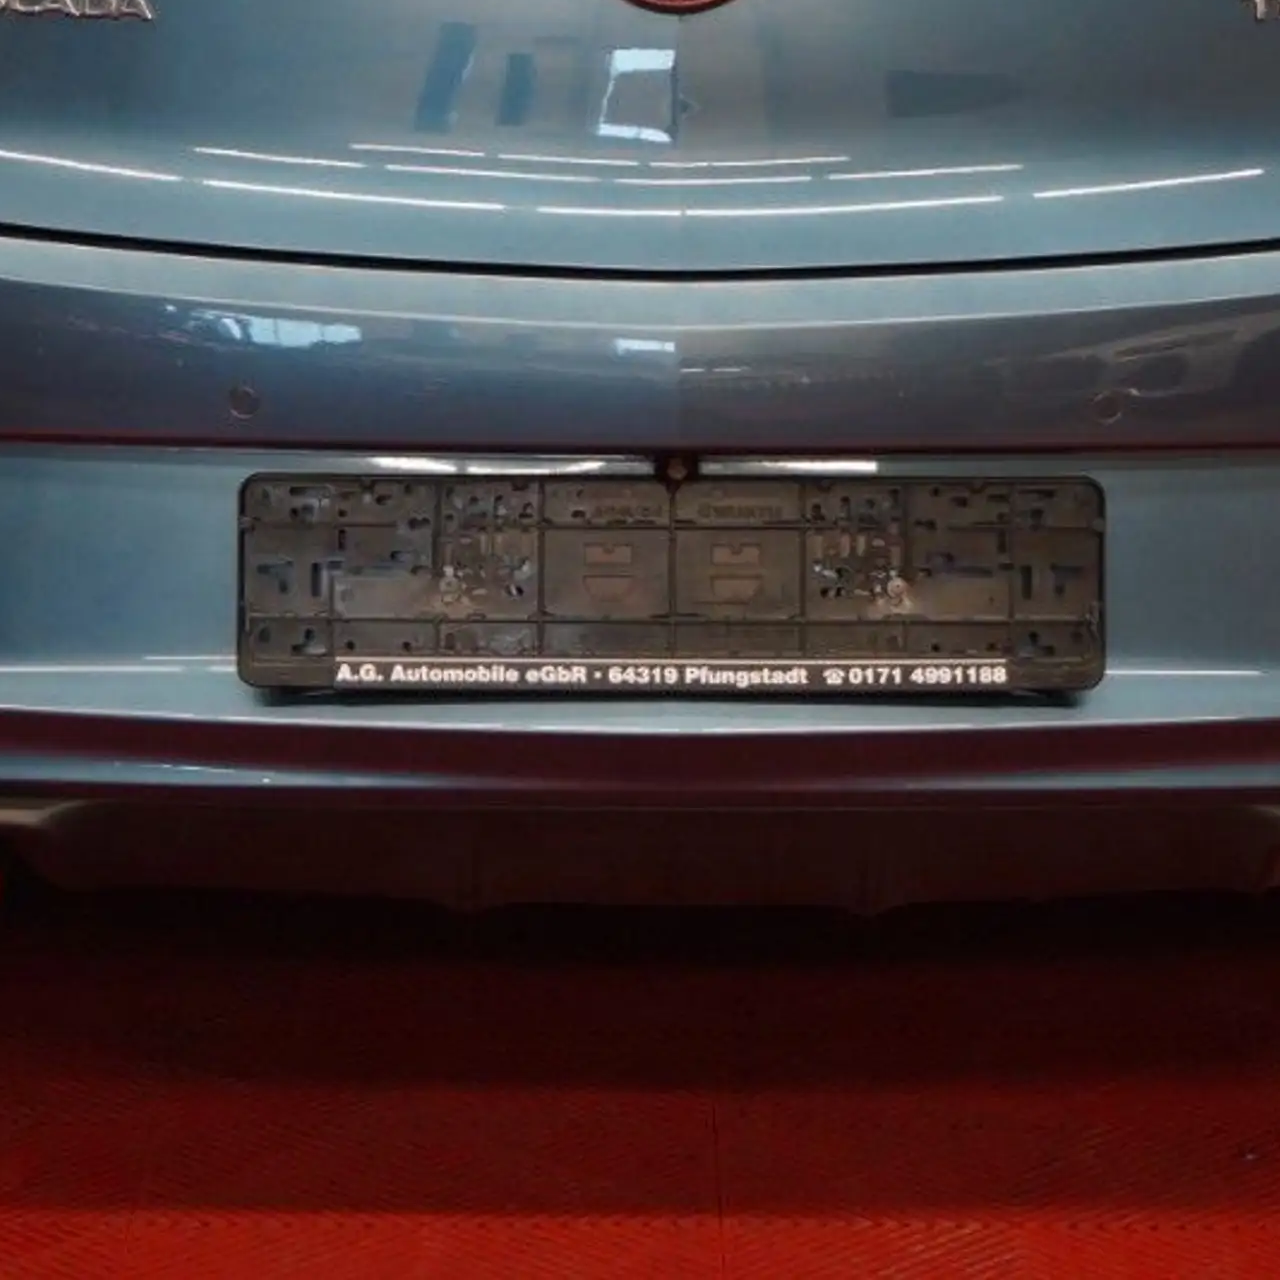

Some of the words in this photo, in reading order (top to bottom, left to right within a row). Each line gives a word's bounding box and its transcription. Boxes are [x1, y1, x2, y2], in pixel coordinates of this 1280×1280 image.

[336, 664, 383, 682] A.G.
[390, 664, 518, 683] Automobile
[525, 665, 587, 684] eGbR
[608, 666, 678, 684] 64319
[684, 666, 808, 688] Pfungstadt
[848, 666, 902, 684] 0171
